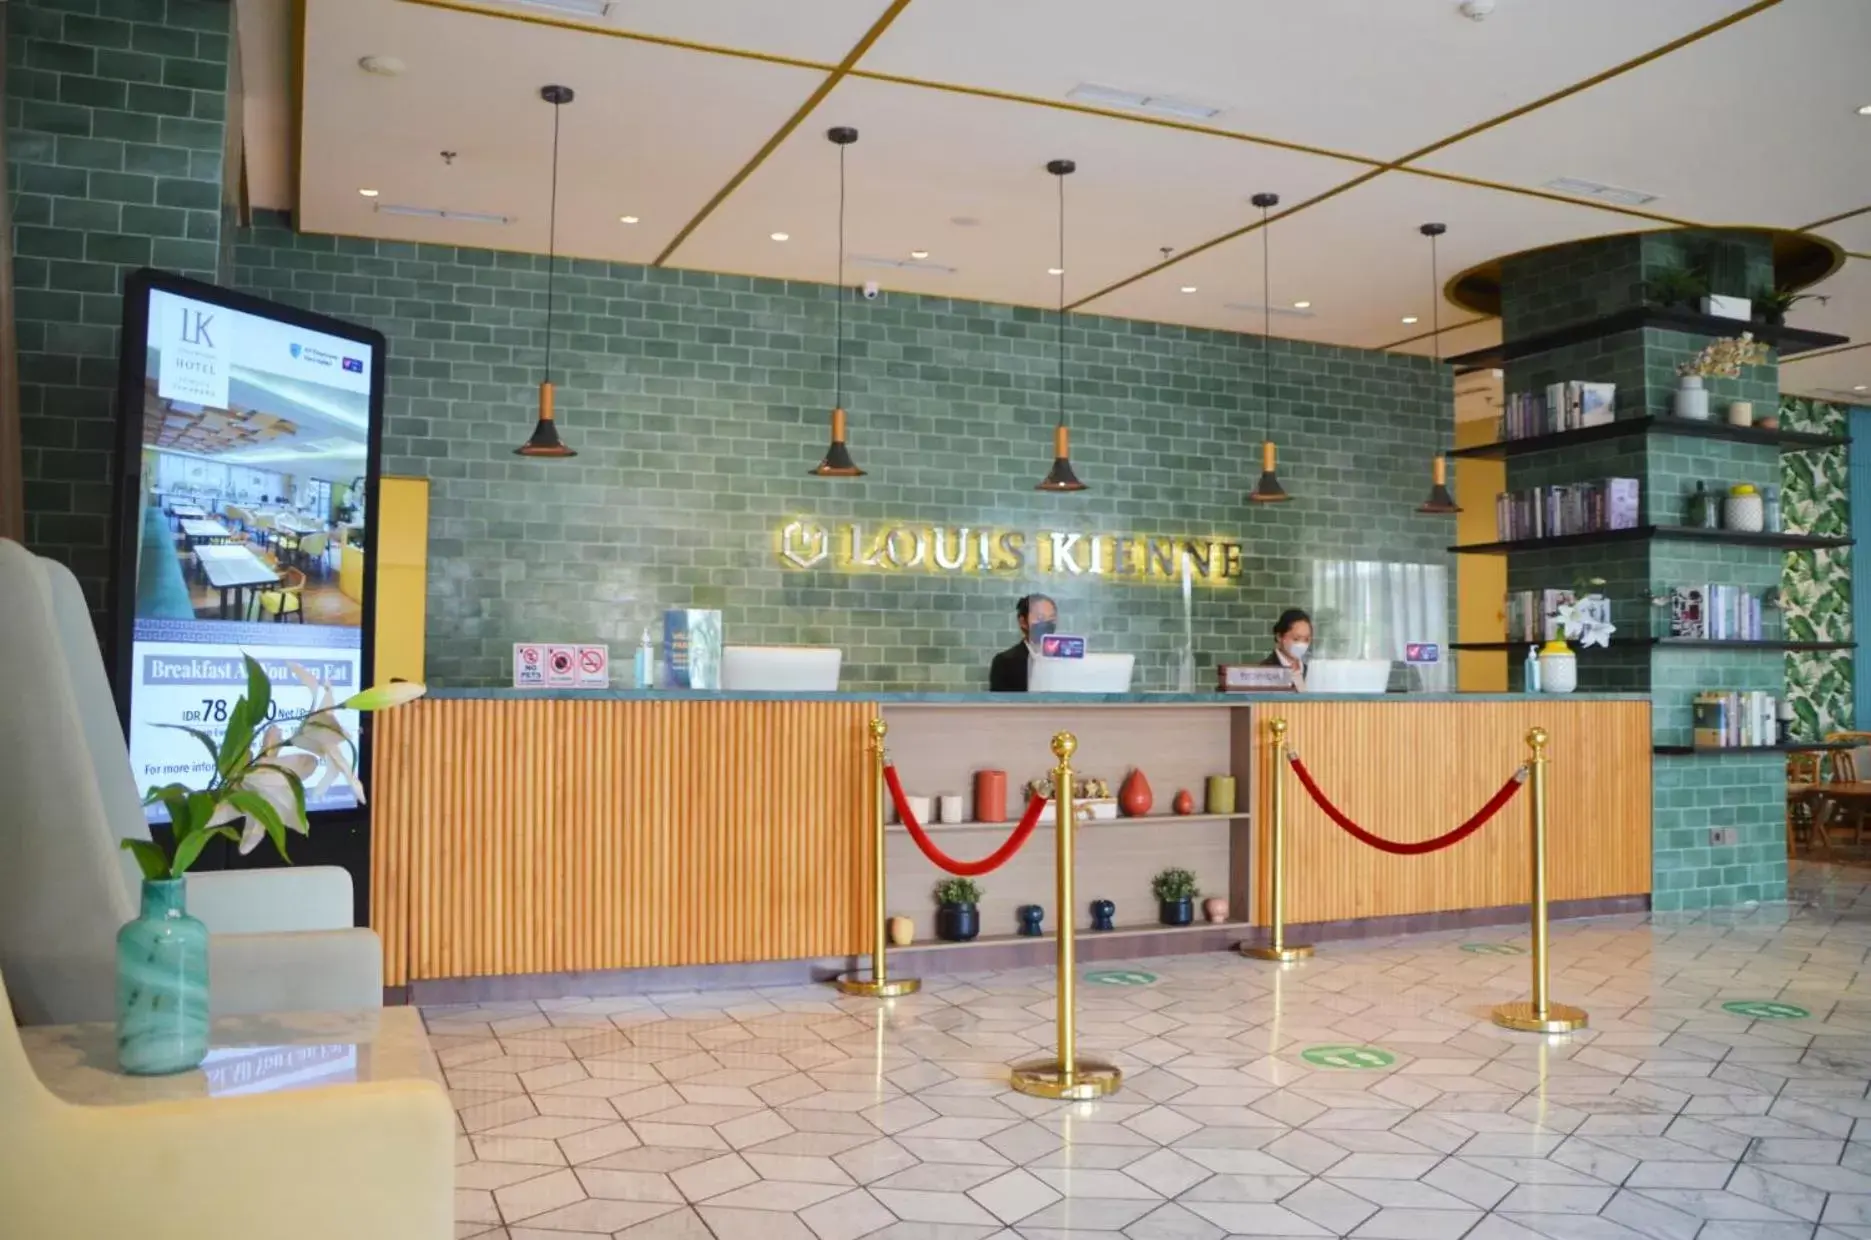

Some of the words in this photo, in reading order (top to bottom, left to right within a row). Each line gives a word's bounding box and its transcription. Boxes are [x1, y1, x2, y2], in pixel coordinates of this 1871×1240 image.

[176, 358, 216, 376] HOTEL
[850, 522, 1023, 570] LOUIS
[1049, 532, 1243, 578] KIENNE
[151, 659, 232, 680] Breakfast
[323, 664, 347, 681] Eat
[182, 710, 200, 722] IDR
[144, 764, 161, 775] For
[163, 763, 190, 774] more
